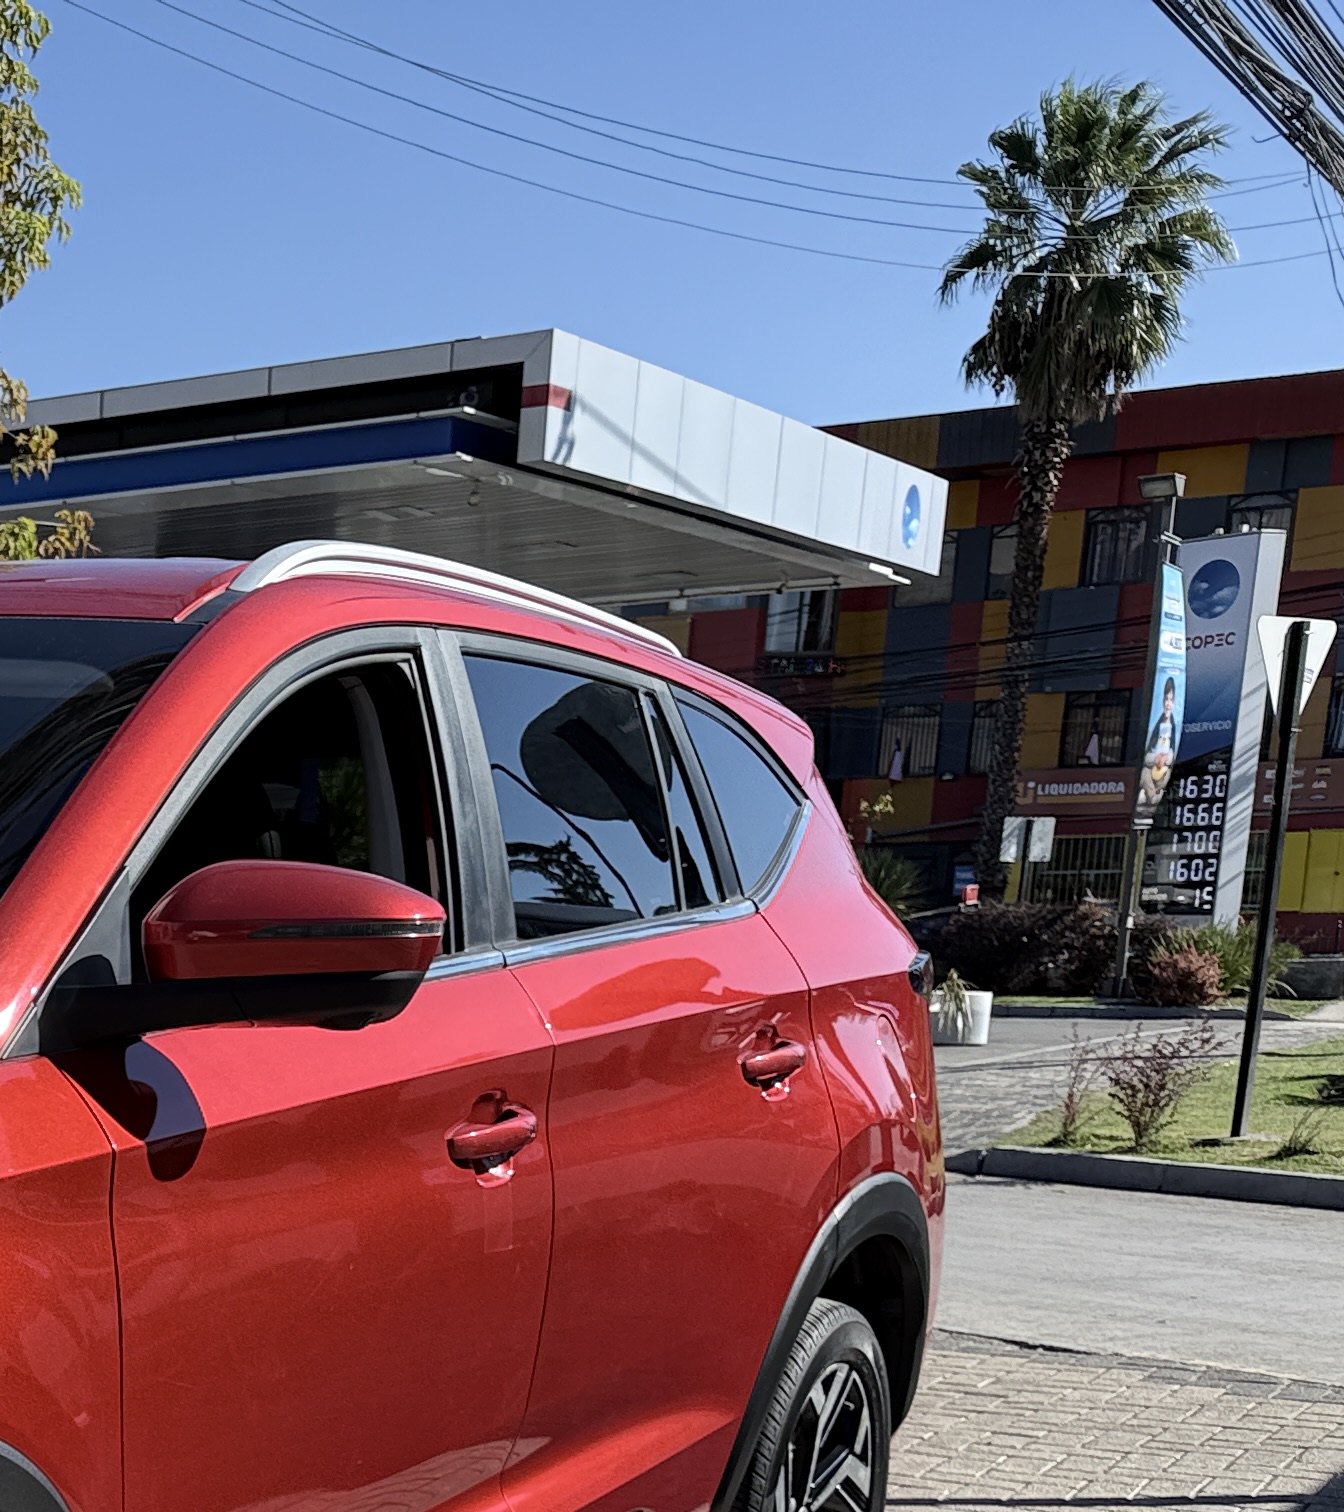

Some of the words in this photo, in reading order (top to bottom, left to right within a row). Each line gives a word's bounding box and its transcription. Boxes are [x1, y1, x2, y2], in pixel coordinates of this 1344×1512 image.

[1036, 781, 1125, 796] LIQUIDADORA
[1178, 774, 1227, 799] 1630
[1169, 858, 1218, 882] 1602
